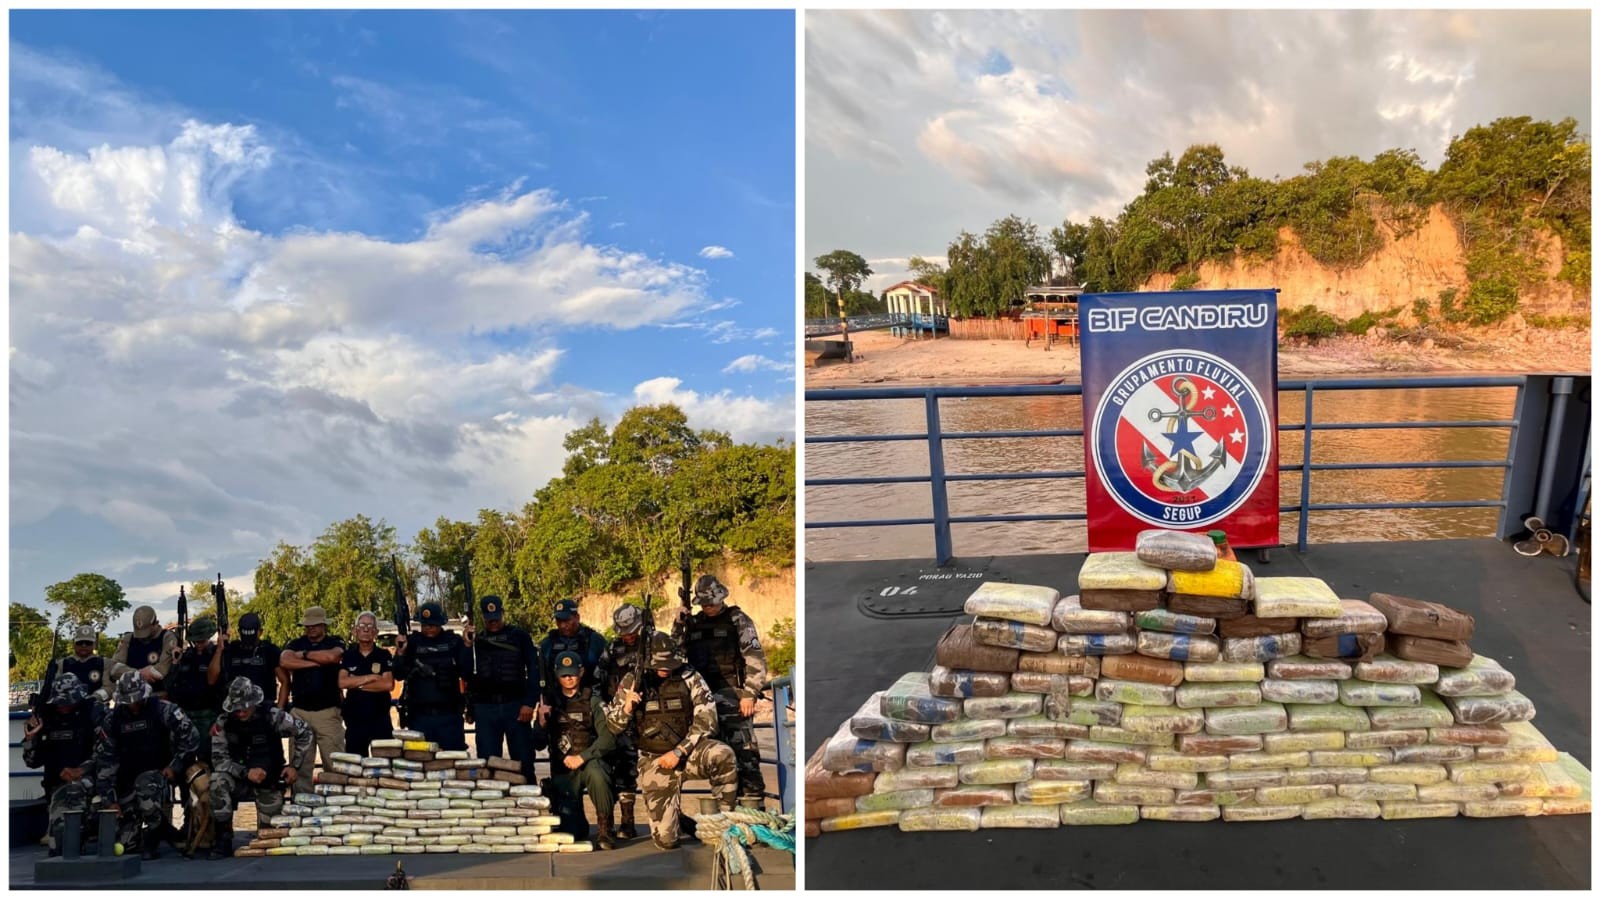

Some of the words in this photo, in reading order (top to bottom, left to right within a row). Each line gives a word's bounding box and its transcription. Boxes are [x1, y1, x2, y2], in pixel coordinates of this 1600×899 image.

[1088, 308, 1137, 332] BIF
[1141, 303, 1269, 331] CANDIRU
[1113, 359, 1192, 406] GRUPAMENTO
[1197, 361, 1247, 401] FLUVIAL
[1163, 505, 1201, 521] SEGUP
[879, 586, 918, 596] 04
